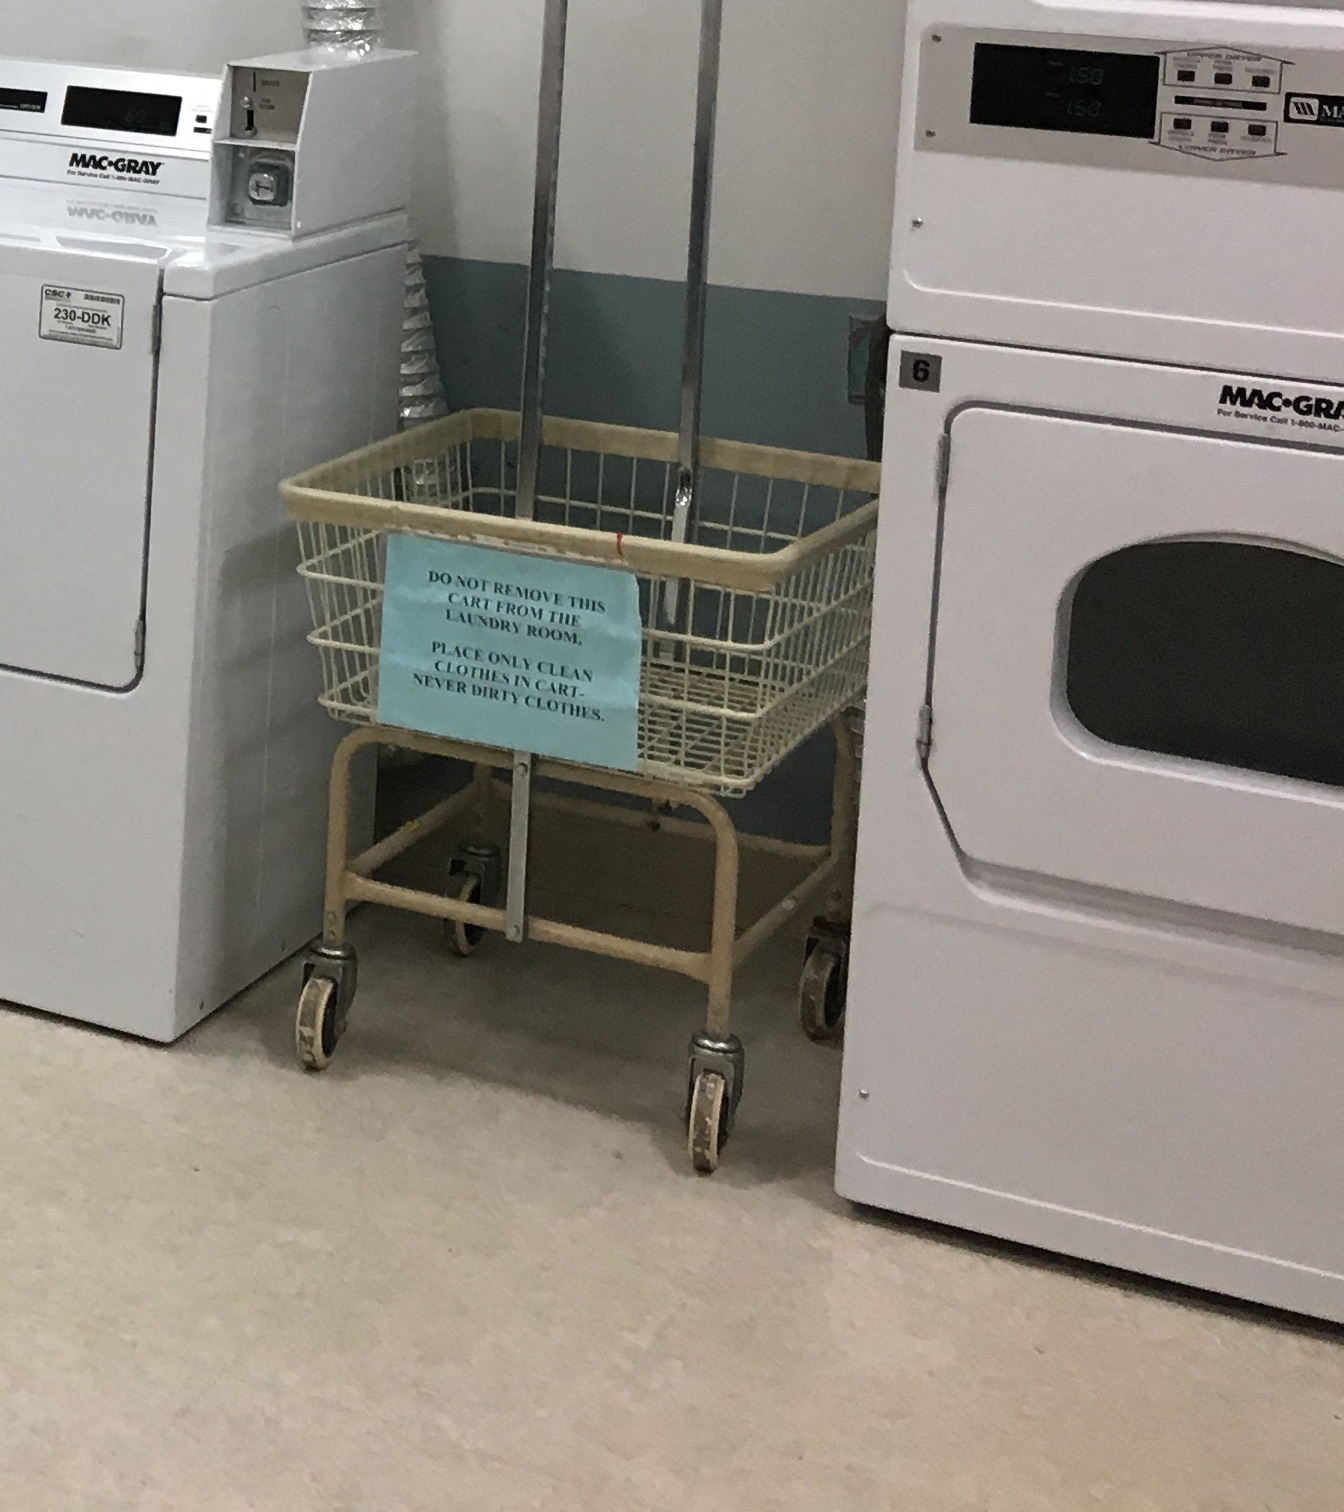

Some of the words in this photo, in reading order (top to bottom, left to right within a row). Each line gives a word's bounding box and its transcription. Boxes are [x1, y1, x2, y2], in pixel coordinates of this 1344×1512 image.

[53, 308, 111, 327] 230-DDK
[911, 360, 929, 383] 6
[1217, 408, 1233, 417] For
[1234, 410, 1268, 422] Service
[1270, 416, 1288, 424] Call
[428, 571, 452, 585] DO
[457, 575, 490, 592] NOT
[493, 581, 562, 606] REMOVE
[568, 595, 606, 613] THIS
[448, 592, 492, 610] CART
[496, 601, 543, 621] FROM
[549, 610, 582, 627] THE
[446, 609, 525, 634] LAUNDRY
[527, 624, 583, 646] ROOM.
[432, 641, 486, 662] PLACE
[488, 651, 532, 671] ONLY
[537, 660, 592, 683] CLEAN
[434, 660, 510, 685] CLOTHES
[514, 674, 531, 689] IN
[535, 678, 585, 699] CART-
[413, 673, 466, 694] NEVER
[471, 684, 520, 705] DIRTY
[524, 694, 605, 722] CLOTHES.
